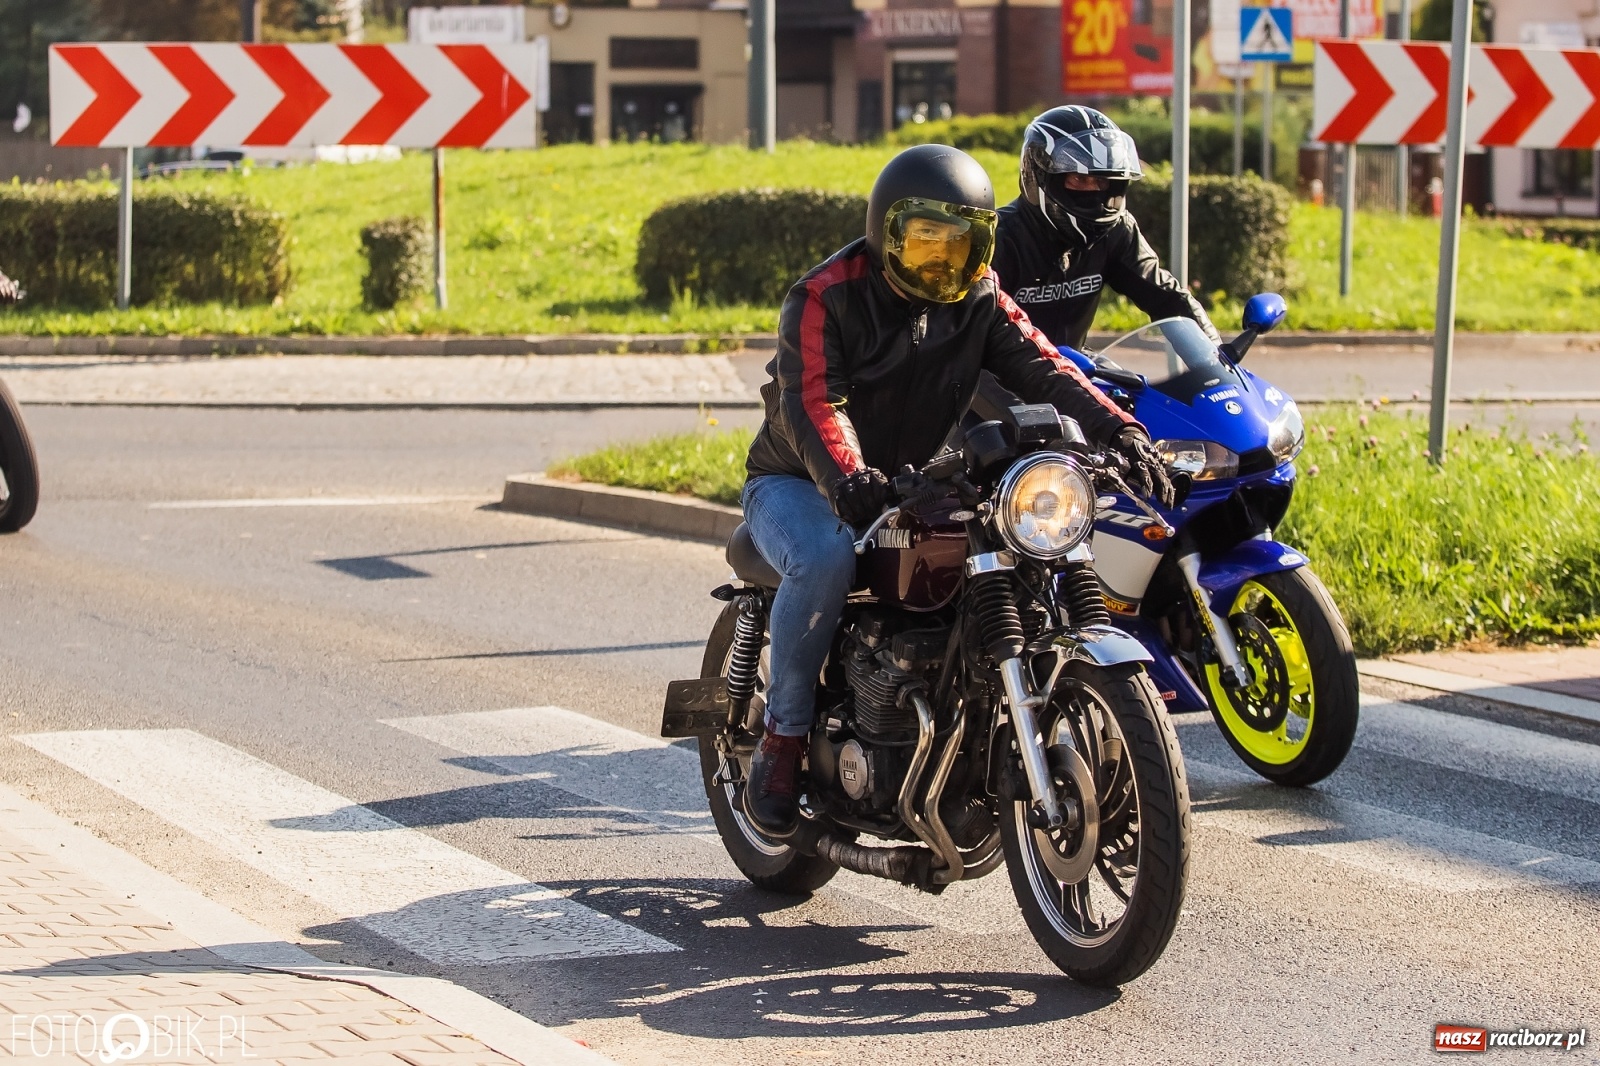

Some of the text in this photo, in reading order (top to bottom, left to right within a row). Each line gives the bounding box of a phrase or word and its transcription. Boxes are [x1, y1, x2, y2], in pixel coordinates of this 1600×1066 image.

[1014, 274, 1102, 303] ARLEN NESS
[1208, 389, 1240, 403] YAMAHA
[878, 529, 911, 548] YAMAHA
